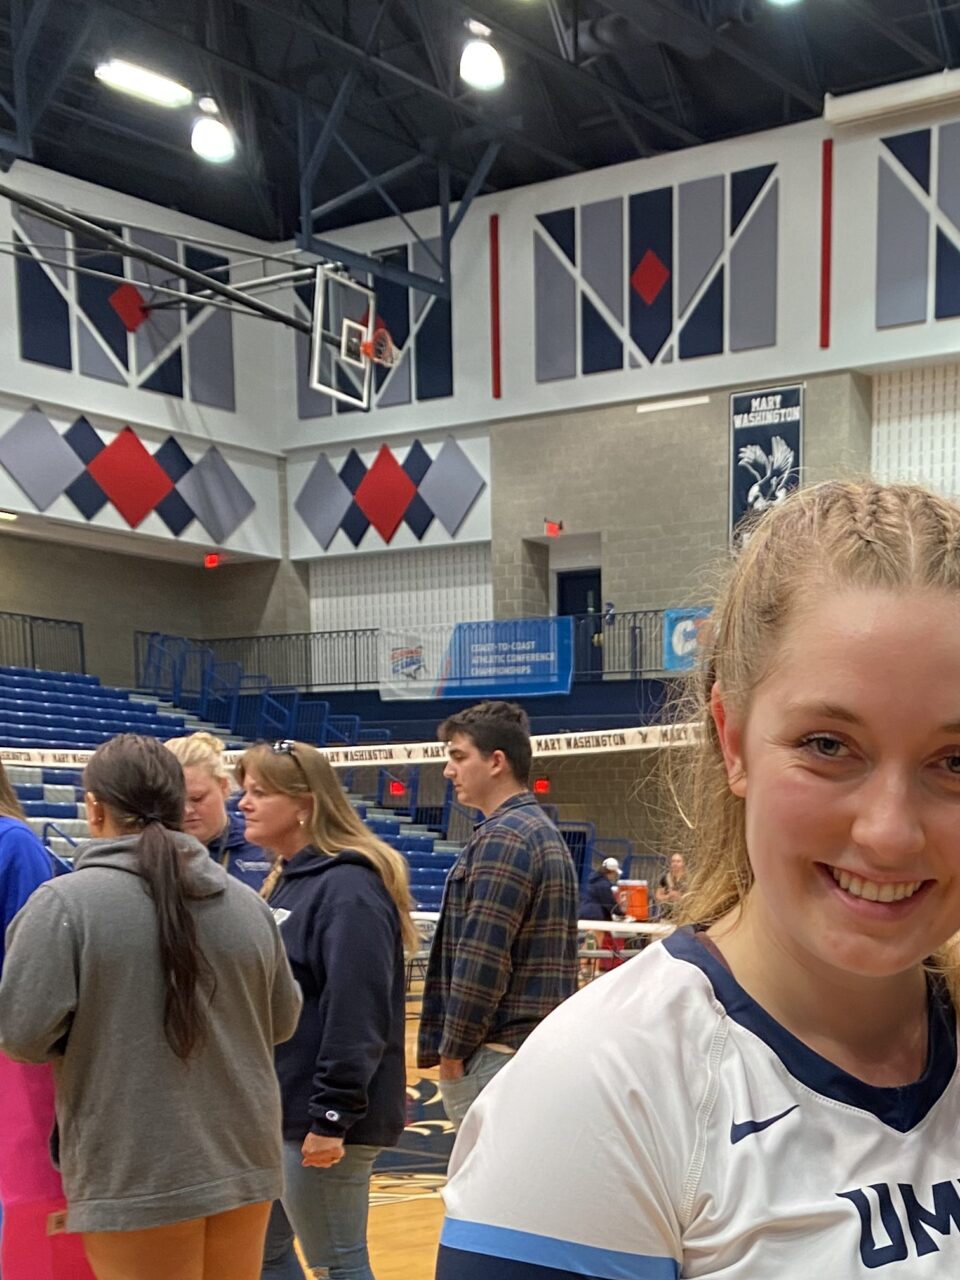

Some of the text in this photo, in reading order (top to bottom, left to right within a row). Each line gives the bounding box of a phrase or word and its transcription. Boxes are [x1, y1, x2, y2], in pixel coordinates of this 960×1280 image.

[751, 395, 782, 412] MARY
[733, 406, 801, 429] WASHINGTON
[536, 733, 627, 752] MARY WASHINGTON
[343, 748, 394, 762] WASHINGTON
[422, 746, 446, 758] MARY
